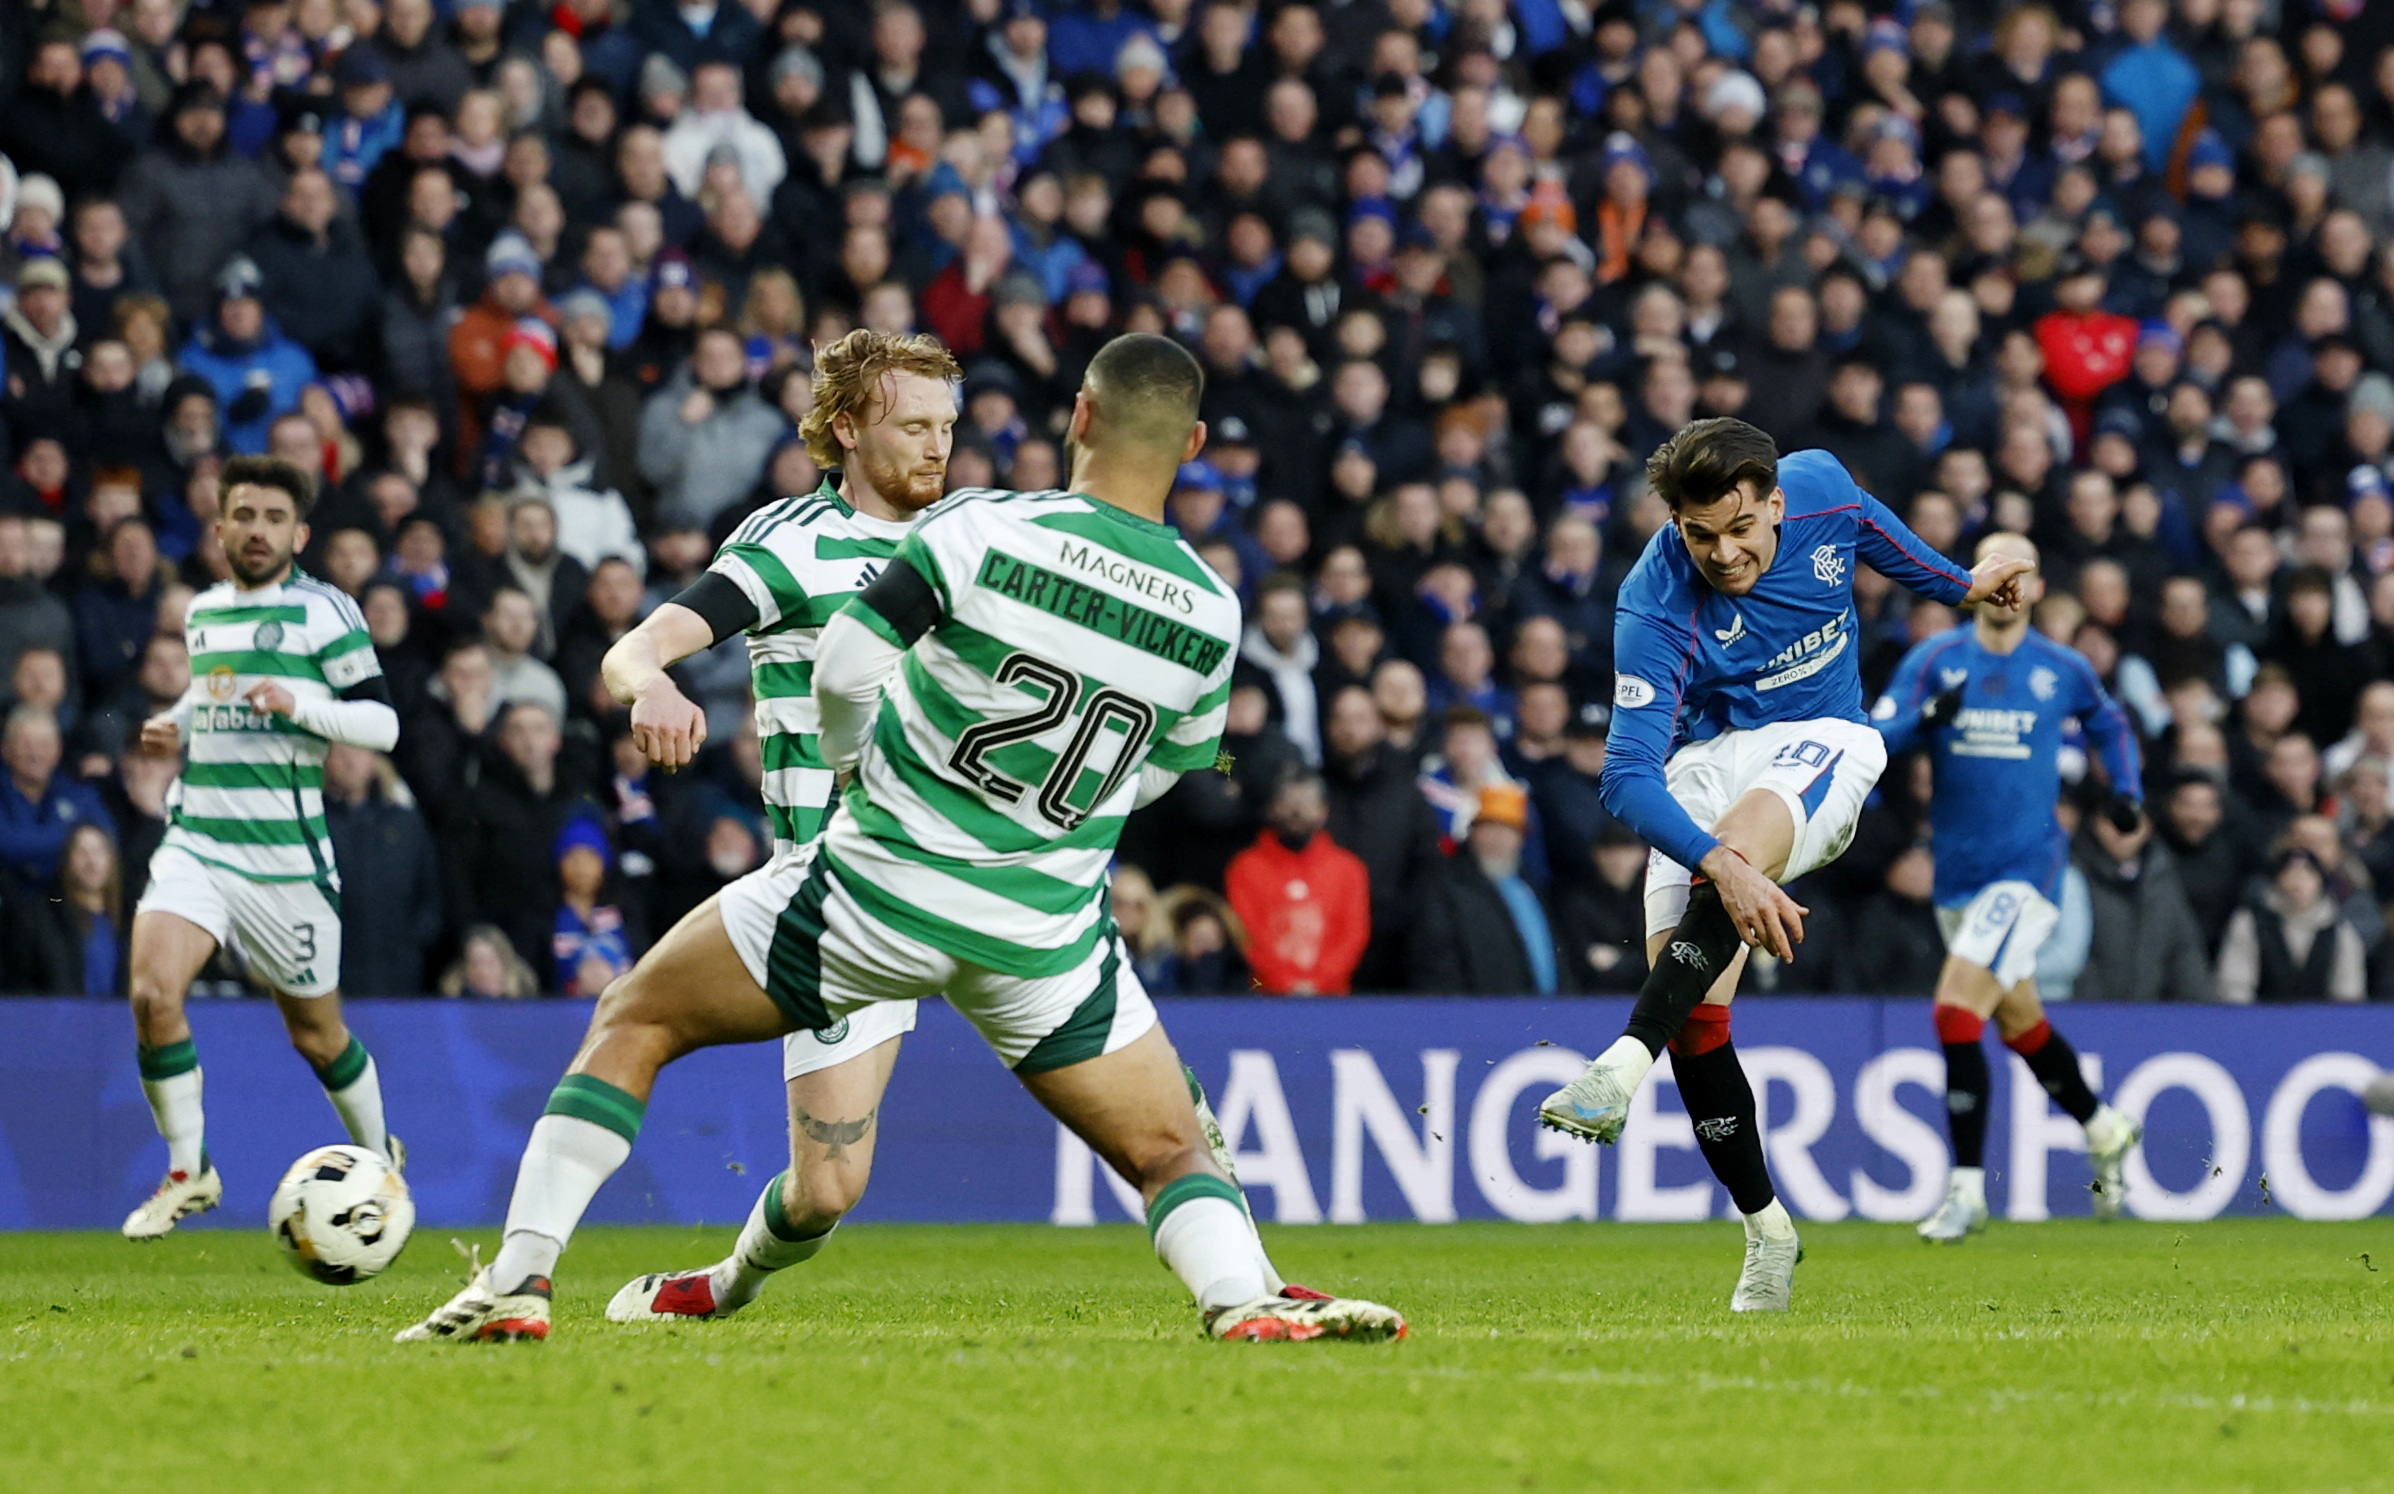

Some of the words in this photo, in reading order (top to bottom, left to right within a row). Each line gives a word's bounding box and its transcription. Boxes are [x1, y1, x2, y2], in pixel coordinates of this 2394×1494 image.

[982, 552, 1225, 678] CARTER-VICKERS
[1059, 540, 1196, 616] MAGNERS
[192, 705, 273, 733] afabet
[945, 650, 1158, 833] 20
[293, 923, 317, 962] 3
